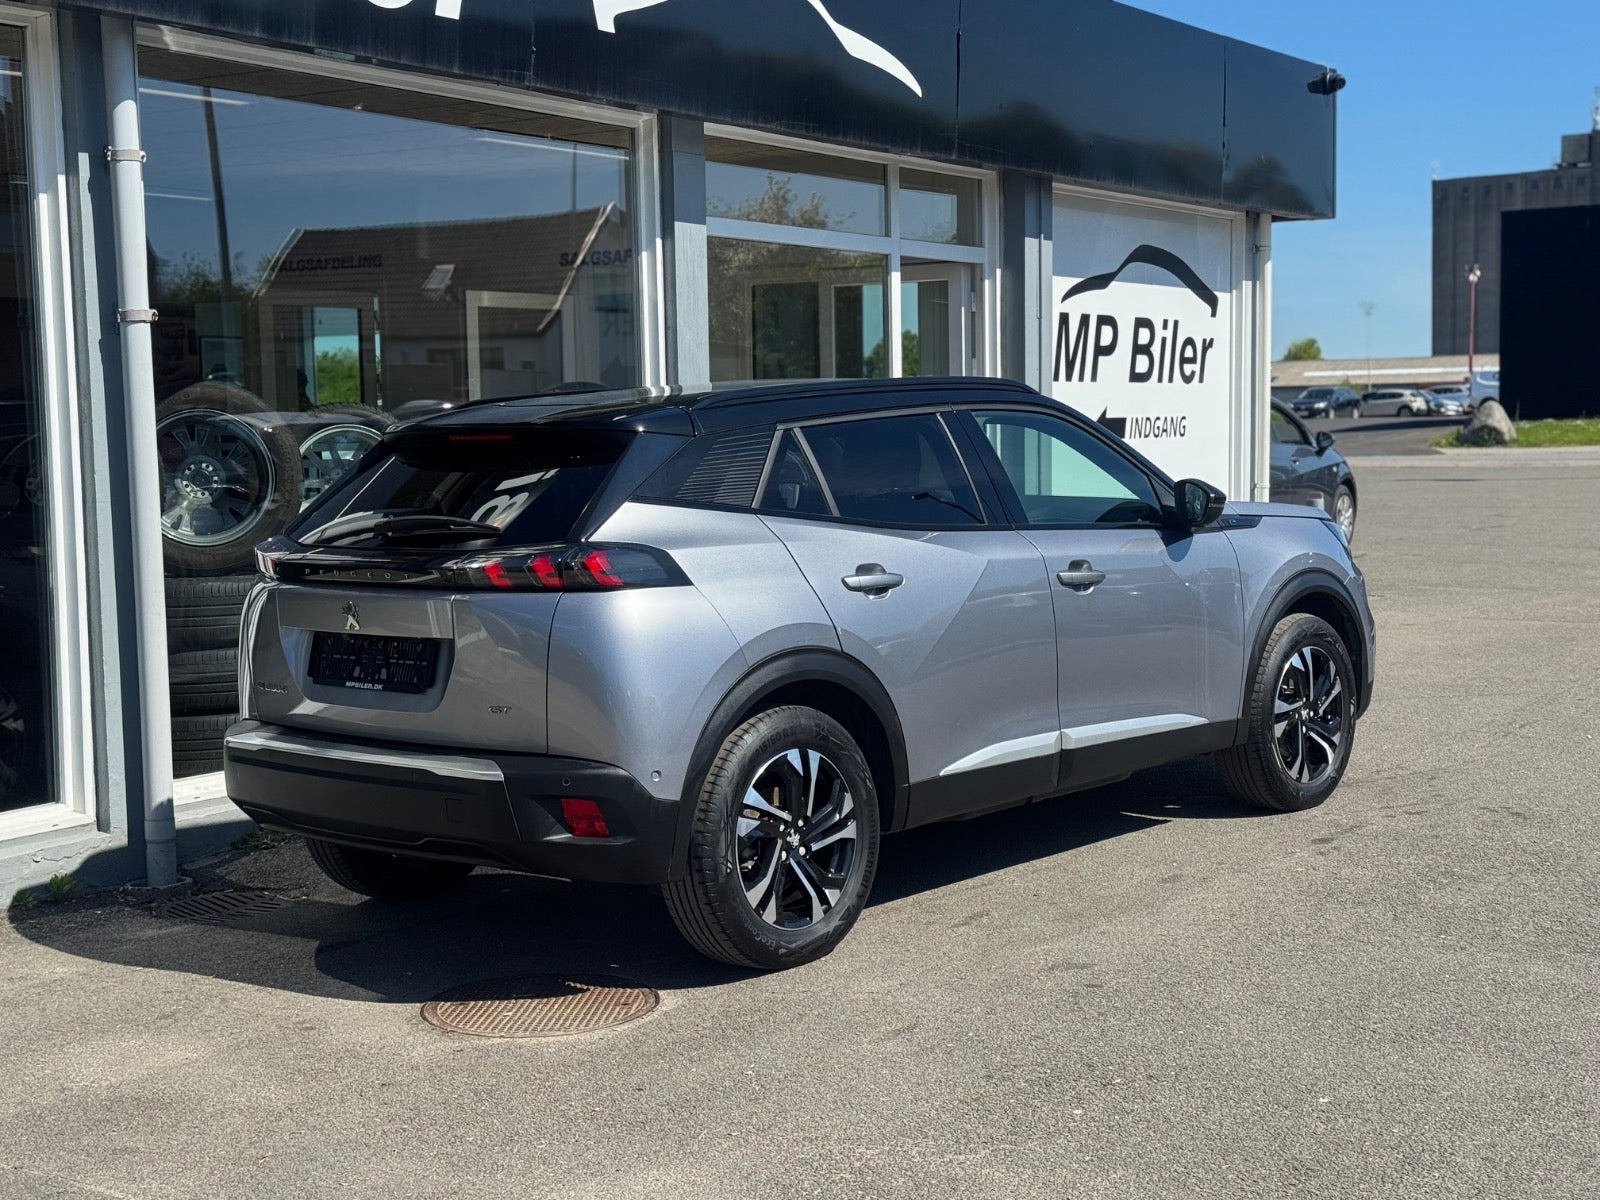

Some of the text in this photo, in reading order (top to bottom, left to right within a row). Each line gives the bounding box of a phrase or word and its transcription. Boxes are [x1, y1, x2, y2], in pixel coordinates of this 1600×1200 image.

[1052, 311, 1215, 385] MP Biler
[1129, 416, 1187, 439] INDGANG
[304, 568, 410, 580] PEUGEOT
[345, 681, 384, 691] MPBILER.DK
[487, 704, 513, 715] GT
